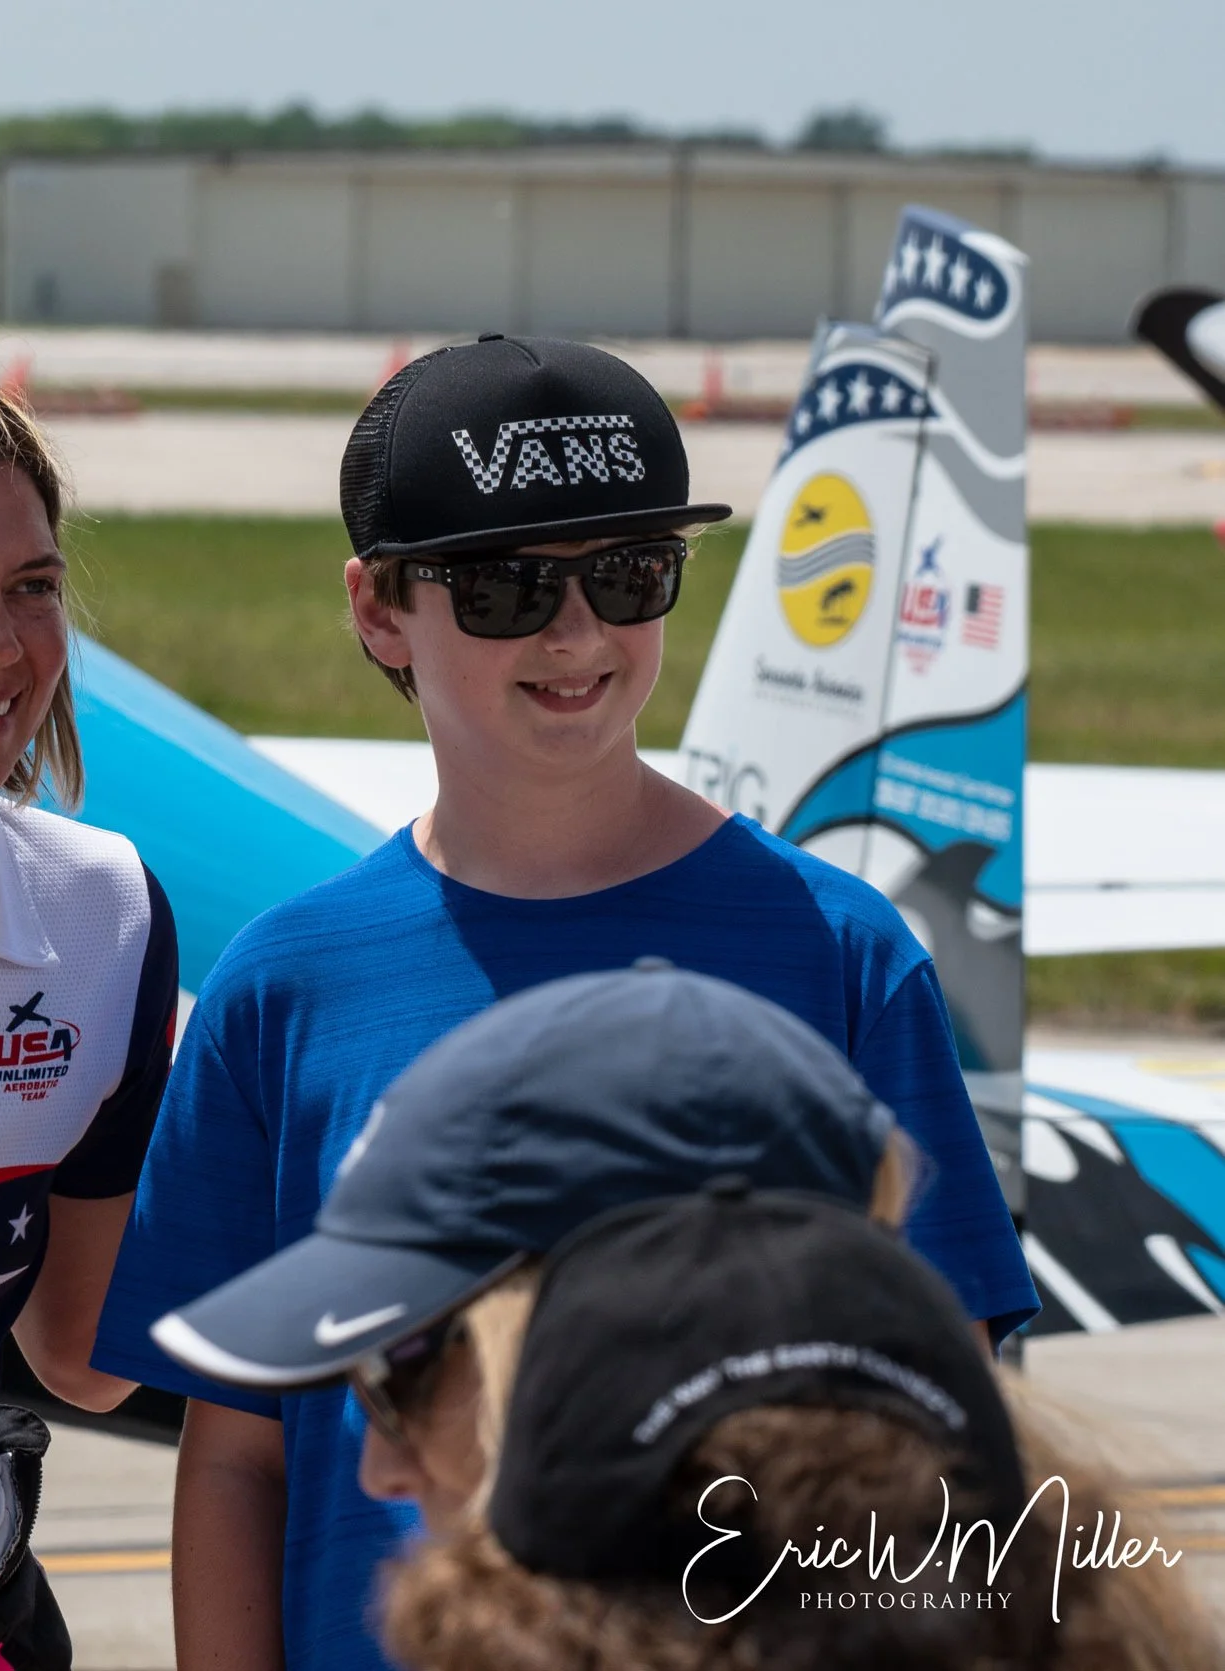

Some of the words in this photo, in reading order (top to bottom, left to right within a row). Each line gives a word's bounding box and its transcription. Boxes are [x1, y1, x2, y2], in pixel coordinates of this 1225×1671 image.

[451, 415, 646, 494] VANS
[3, 1079, 60, 1094] AEROBATIC
[21, 1090, 47, 1102] TEAM
